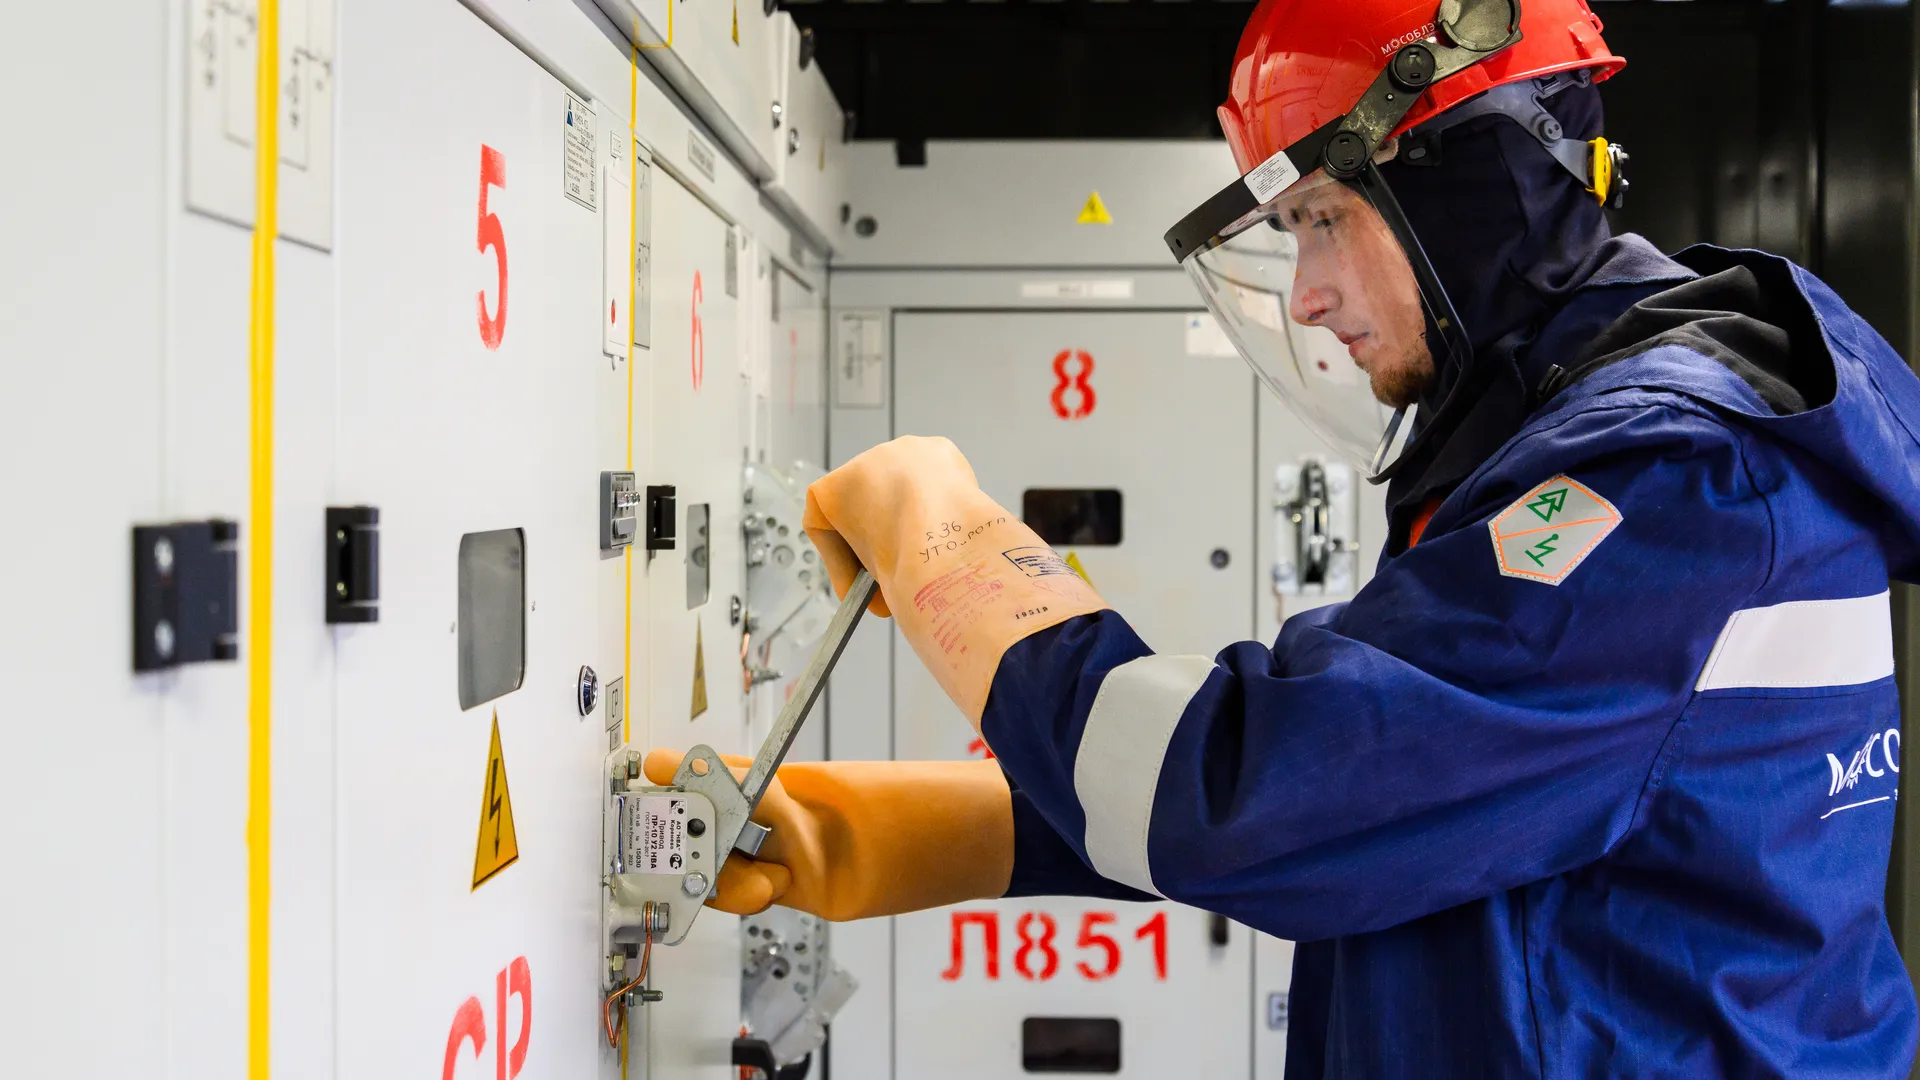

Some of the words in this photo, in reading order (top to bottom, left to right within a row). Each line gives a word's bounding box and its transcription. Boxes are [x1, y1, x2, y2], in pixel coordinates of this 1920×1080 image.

[1381, 21, 1436, 55] МОСОБЛЭ
[477, 144, 508, 350] 5
[691, 270, 703, 390] 6
[1050, 349, 1097, 420] 8
[939, 521, 962, 538] 36
[650, 840, 658, 850] У2
[658, 820, 666, 850] Привод
[650, 852, 658, 869] НВА
[940, 911, 1169, 981] Л851
